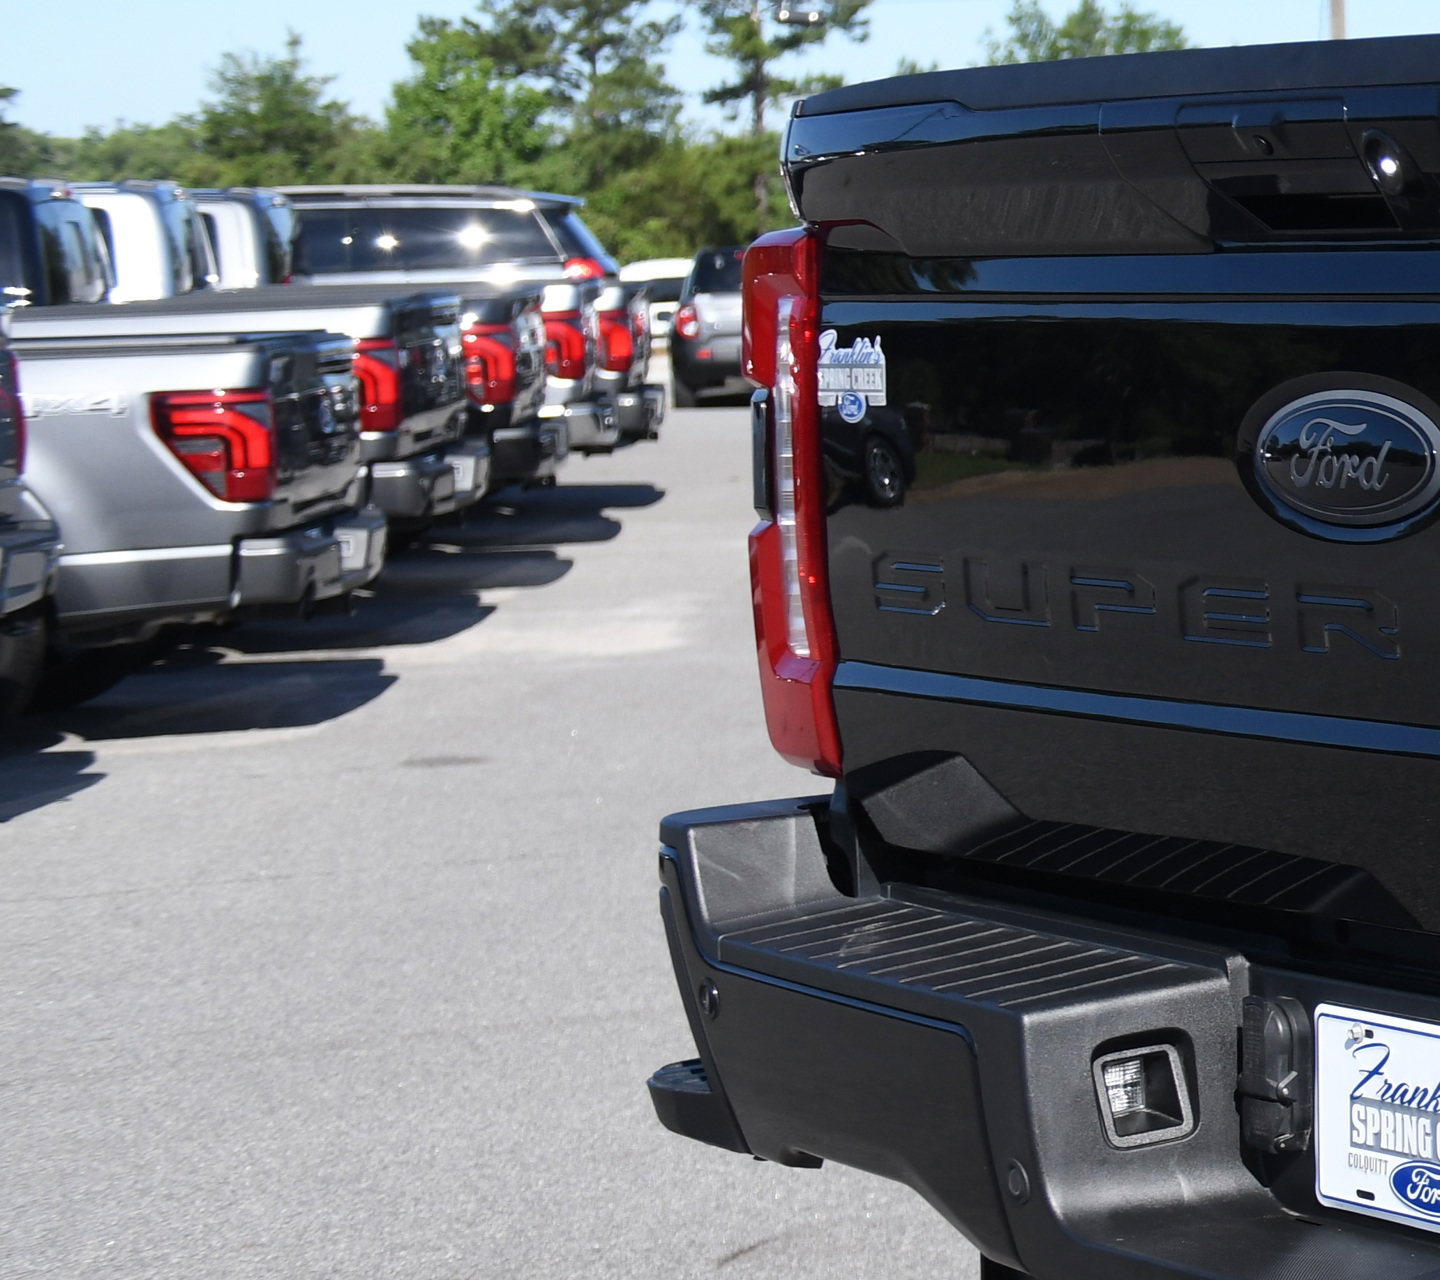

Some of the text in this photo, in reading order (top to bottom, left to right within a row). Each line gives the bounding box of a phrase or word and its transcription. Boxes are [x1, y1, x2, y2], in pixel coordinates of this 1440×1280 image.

[1289, 417, 1393, 492] Ford
[872, 551, 1401, 660] SUPER
[1348, 1152, 1388, 1176] COLQUITT
[1352, 1103, 1434, 1160] SPRING
